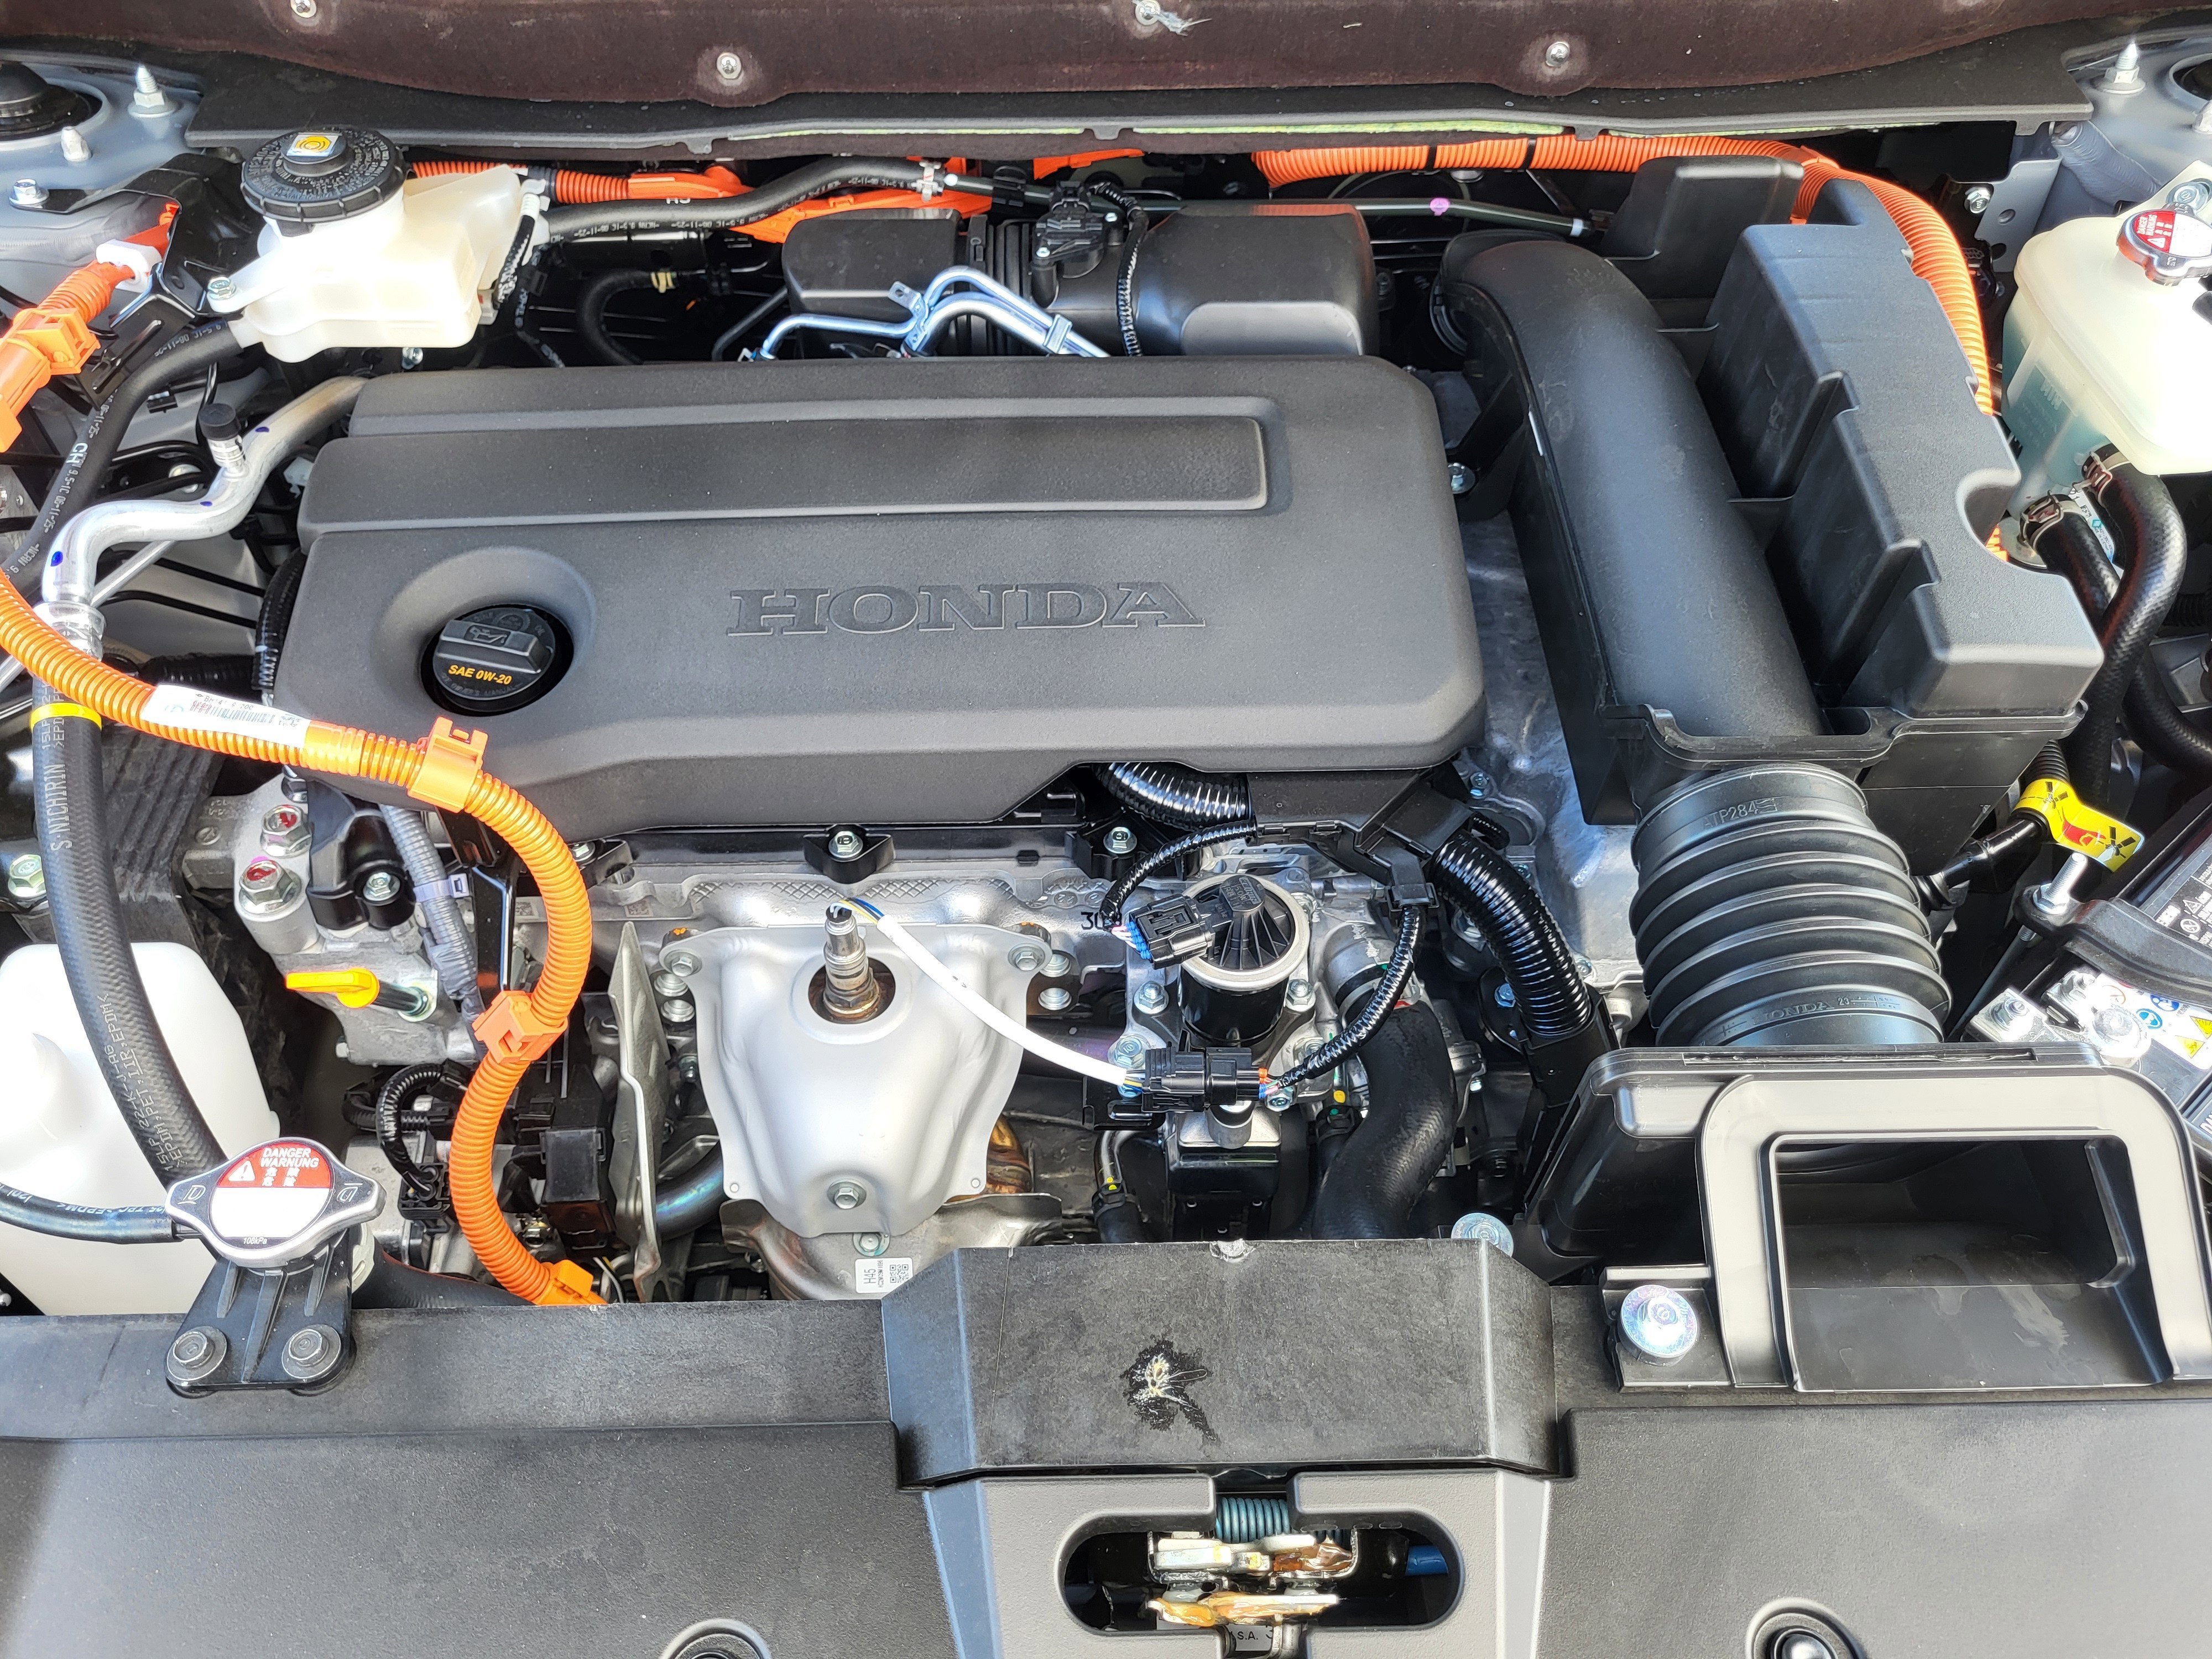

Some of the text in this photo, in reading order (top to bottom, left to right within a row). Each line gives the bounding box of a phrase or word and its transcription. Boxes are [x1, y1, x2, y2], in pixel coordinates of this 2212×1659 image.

[727, 582, 1206, 636] HONDA
[448, 665, 513, 685] SAE 0W-20
[262, 1147, 312, 1159] DANGER
[259, 1157, 320, 1168] WARNUNG
[863, 1269, 877, 1284] H45
